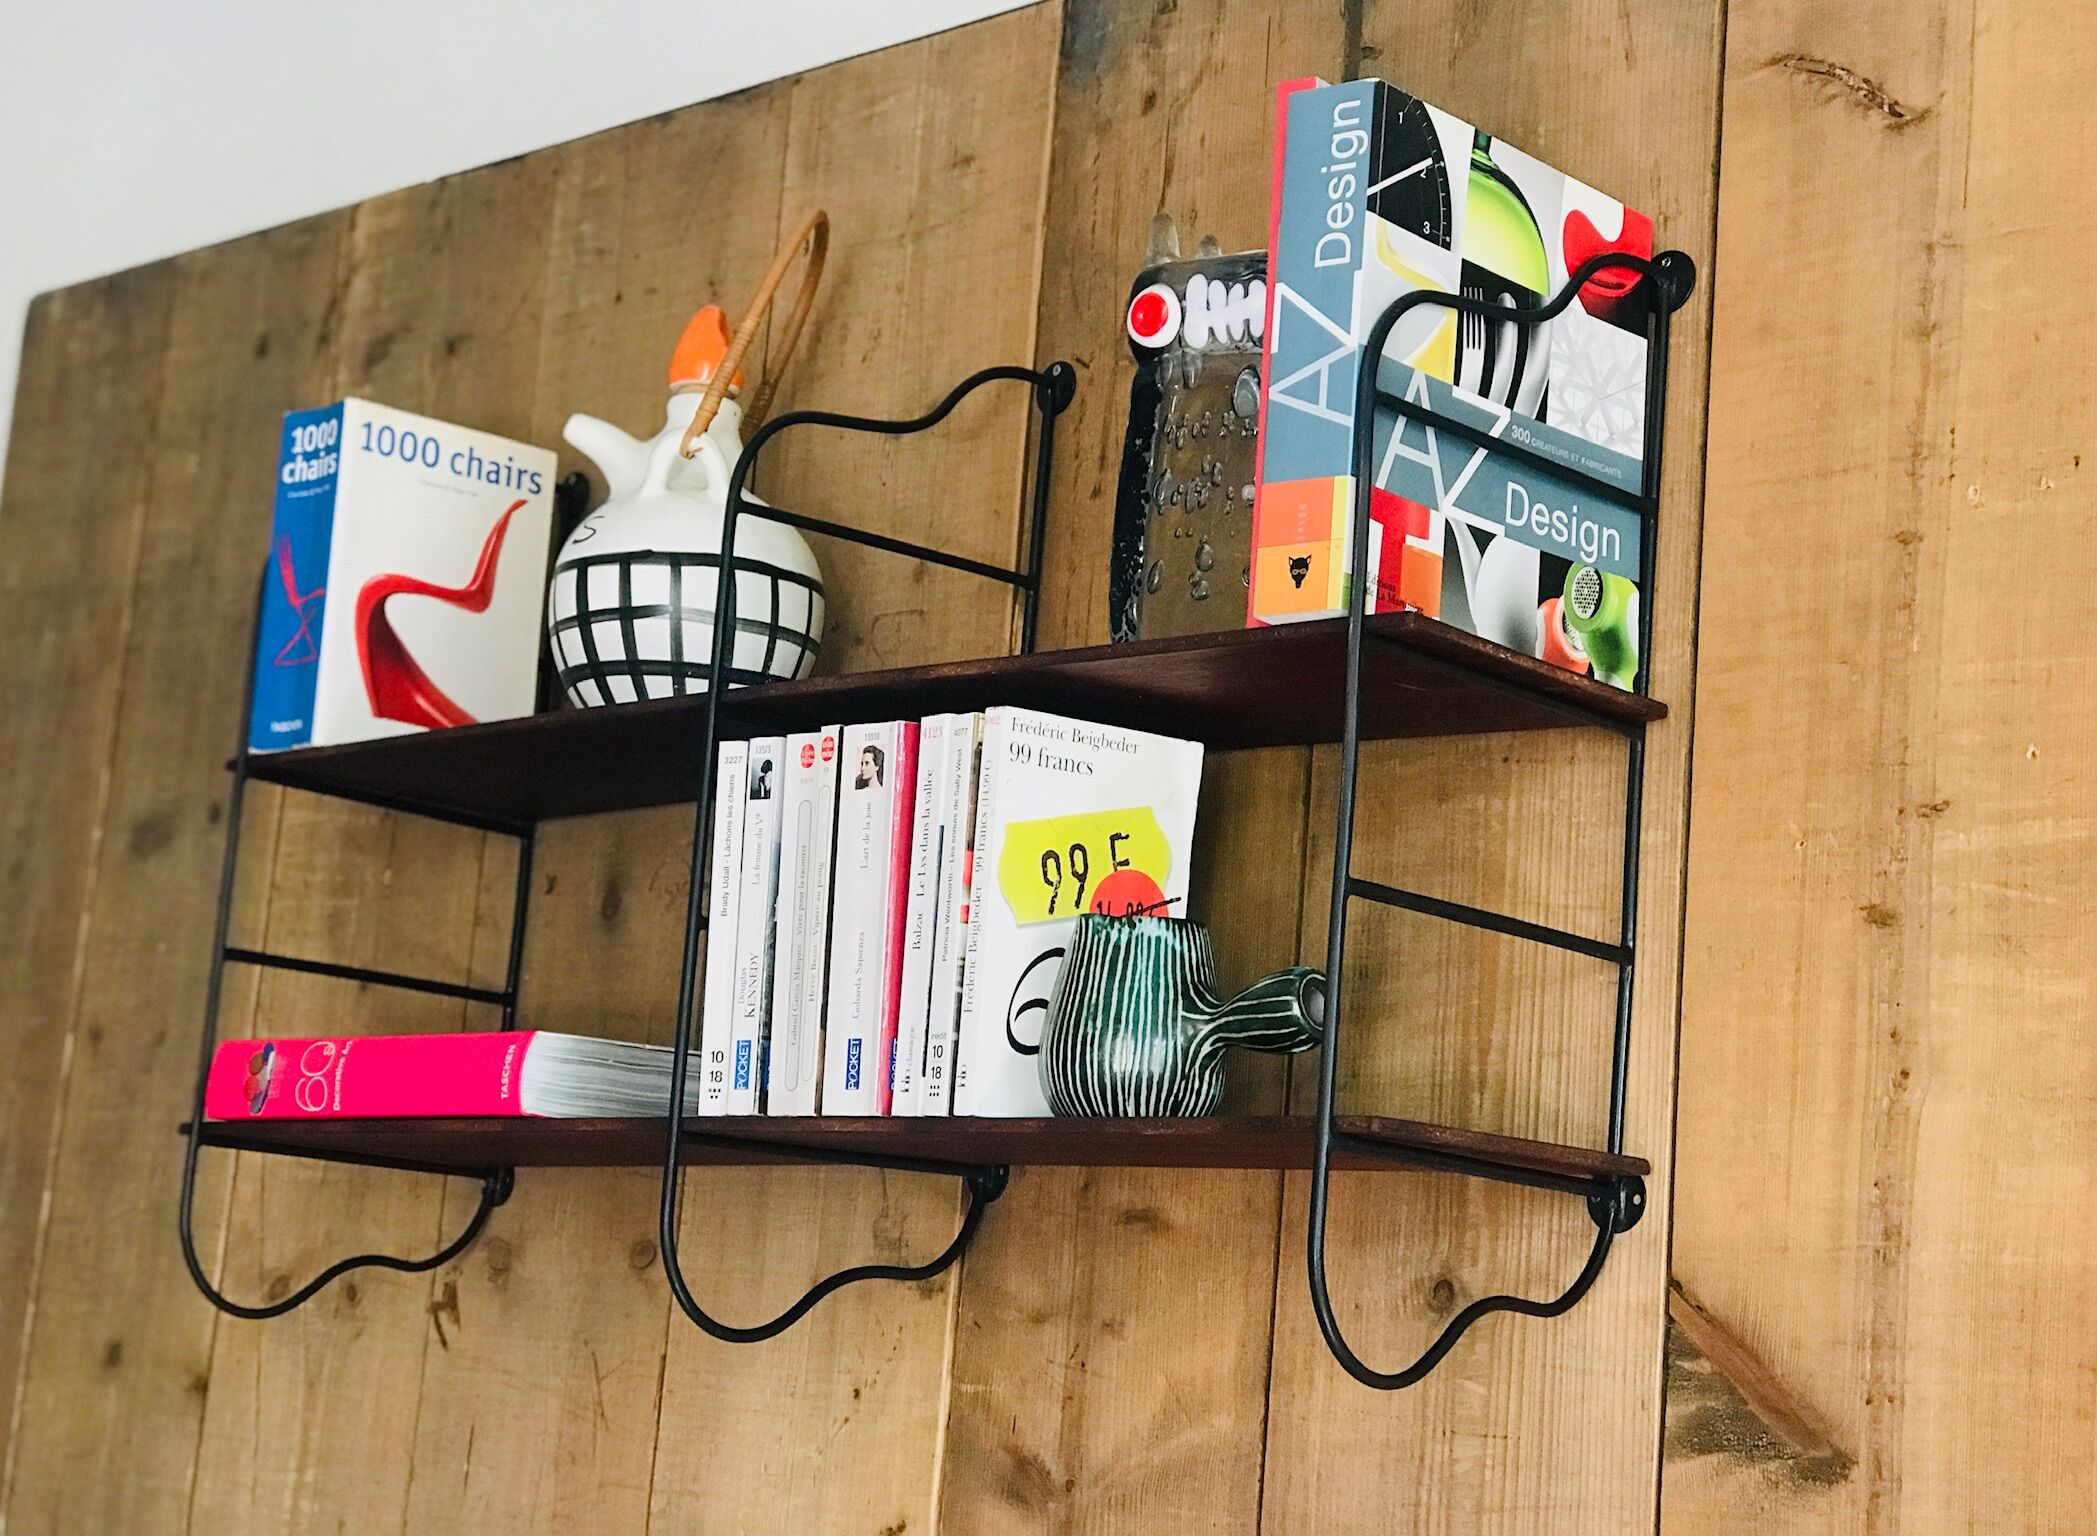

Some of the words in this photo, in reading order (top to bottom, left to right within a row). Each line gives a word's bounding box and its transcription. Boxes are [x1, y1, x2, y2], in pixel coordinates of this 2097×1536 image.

[1398, 111, 1404, 125] 1
[1314, 98, 1369, 268] Design
[1423, 221, 1431, 235] 3
[291, 419, 338, 453] 1000
[1511, 424, 1531, 444] 300
[1571, 452, 1579, 463] ET
[1581, 456, 1622, 478] FABRICANTS
[281, 450, 338, 484] chairs
[361, 421, 440, 468] 1000
[450, 447, 542, 495] chairs
[1505, 480, 1621, 564] Design
[953, 727, 968, 737] 4077
[1011, 717, 1068, 742] Frédéric
[1071, 728, 1140, 755] Beigbeder
[725, 755, 743, 764] 3227
[1009, 742, 1032, 764] 99
[1037, 749, 1094, 776] francs
[728, 774, 736, 803] chiens
[923, 769, 934, 800] vallée
[954, 774, 962, 797] Sally
[921, 808, 931, 819] la
[953, 798, 959, 811] de
[724, 820, 733, 857] Lâchons
[755, 827, 763, 839] du
[862, 821, 871, 830] la
[862, 833, 870, 845] de
[920, 822, 930, 852] dans
[977, 812, 987, 851] francs
[753, 843, 762, 873] femme
[918, 856, 928, 877] Lys
[976, 856, 984, 873] 99
[722, 866, 730, 889] Udall
[752, 874, 761, 886] La
[798, 881, 805, 889] la
[916, 881, 925, 897] Le
[1041, 843, 1089, 915] 99
[721, 892, 730, 917] Brady
[816, 891, 822, 901] au
[944, 869, 953, 924] Wentworth
[913, 912, 923, 950] Balzac
[968, 887, 982, 953] Beigbeder
[856, 932, 865, 974] Sapienza
[942, 926, 950, 961] Patricia
[738, 967, 747, 1004] Douglas
[744, 954, 759, 1018] KENNEDY
[964, 960, 976, 1013] Frédéric
[710, 1051, 724, 1064] 10
[736, 1039, 751, 1089] POCKET
[847, 1039, 862, 1090] POCKET
[932, 1044, 944, 1059] 10
[333, 1056, 346, 1112] Decorative
[341, 1040, 353, 1056] Art
[499, 1044, 517, 1100] TASCHEN
[709, 1070, 723, 1083] 18
[931, 1066, 942, 1080] 18
